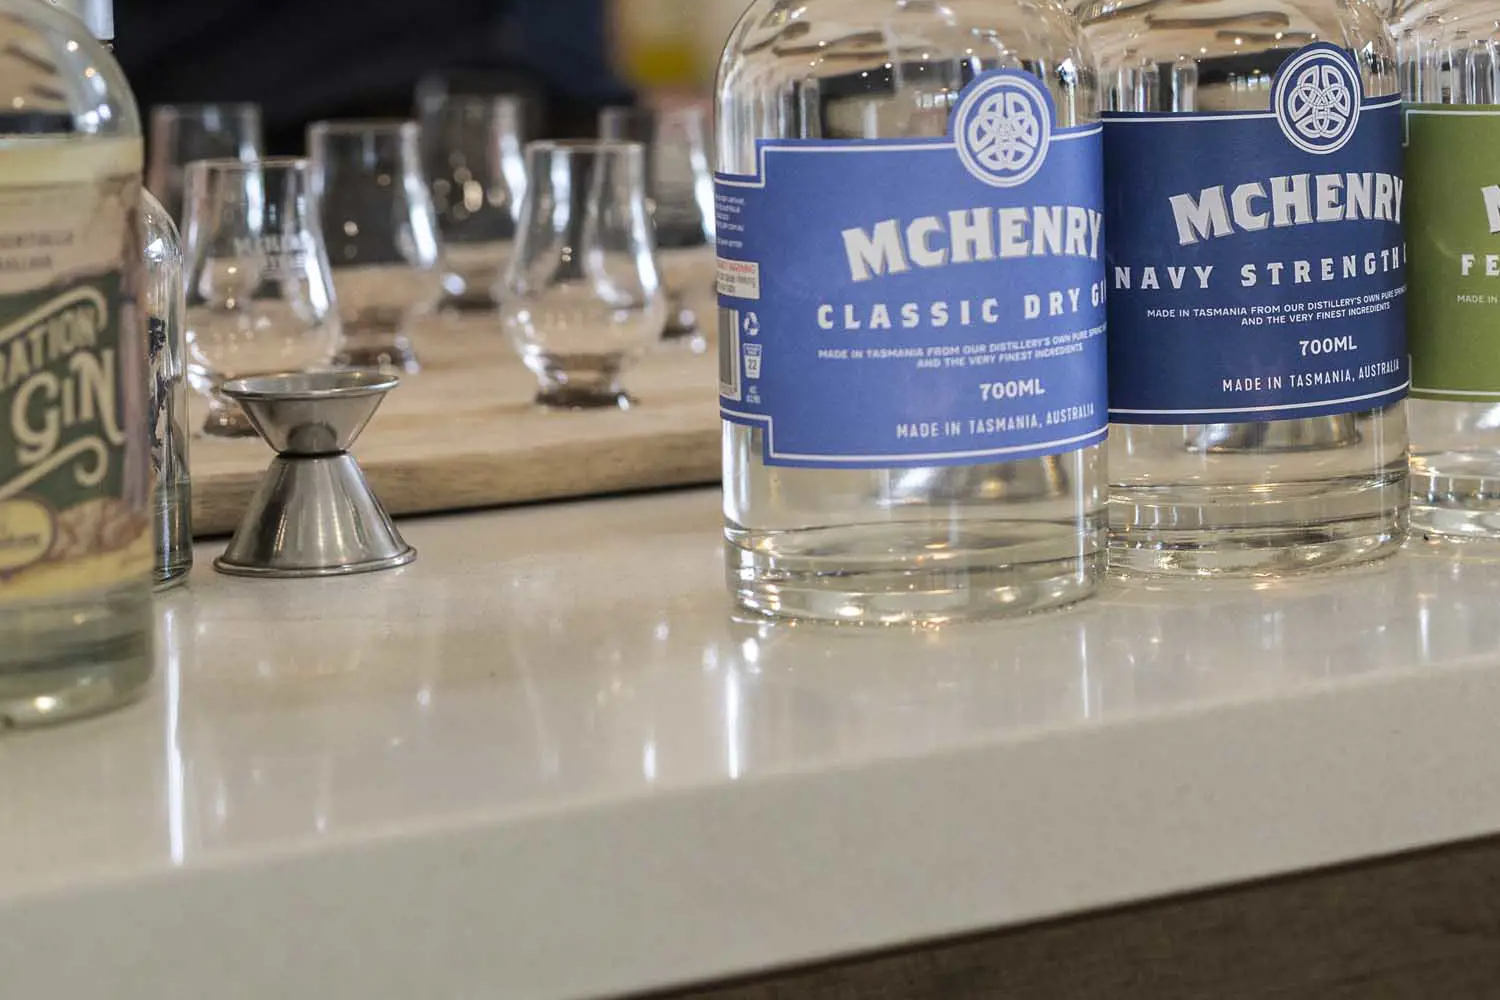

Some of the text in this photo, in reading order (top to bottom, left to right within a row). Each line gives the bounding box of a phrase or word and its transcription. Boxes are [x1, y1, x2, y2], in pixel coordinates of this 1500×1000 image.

[1168, 172, 1404, 246] MCHENRY
[841, 205, 1102, 283] MCHENRY
[1115, 265, 1214, 289] NAVY
[1241, 246, 1399, 287] STRENGTH
[817, 298, 999, 331] CLASSIC
[1023, 287, 1081, 320] DRY
[1147, 308, 1176, 318] MADE
[1179, 308, 1190, 318] IN
[1193, 306, 1248, 318] TASMANIA
[1251, 304, 1281, 315] FROM
[1283, 303, 1305, 313] OUR
[1307, 296, 1362, 311] DISTILLERY'S
[1363, 294, 1381, 304] OWN
[1381, 289, 1395, 301] PURE
[1456, 294, 1485, 303] MADE
[1488, 294, 1499, 304] IN
[1241, 301, 1391, 327] AND THE VERY FINEST INGREDIENTS
[817, 348, 849, 360] MADE
[850, 349, 863, 360] IN
[866, 347, 924, 359] TASMANIA
[926, 345, 960, 357] FROM
[962, 343, 987, 355] OUR
[989, 336, 1051, 353] DISTILLERY'S
[917, 357, 941, 369] AND
[944, 356, 966, 368] THE
[968, 354, 995, 367] VERY
[998, 350, 1033, 364] FINEST
[1299, 335, 1358, 357] 700ML
[979, 378, 1046, 401] 700ML
[1222, 358, 1400, 392] MADE IN TASMANIA, AUSTRALIA
[896, 402, 1094, 439] MADE IN TASMANIA, AUSTRALIA
